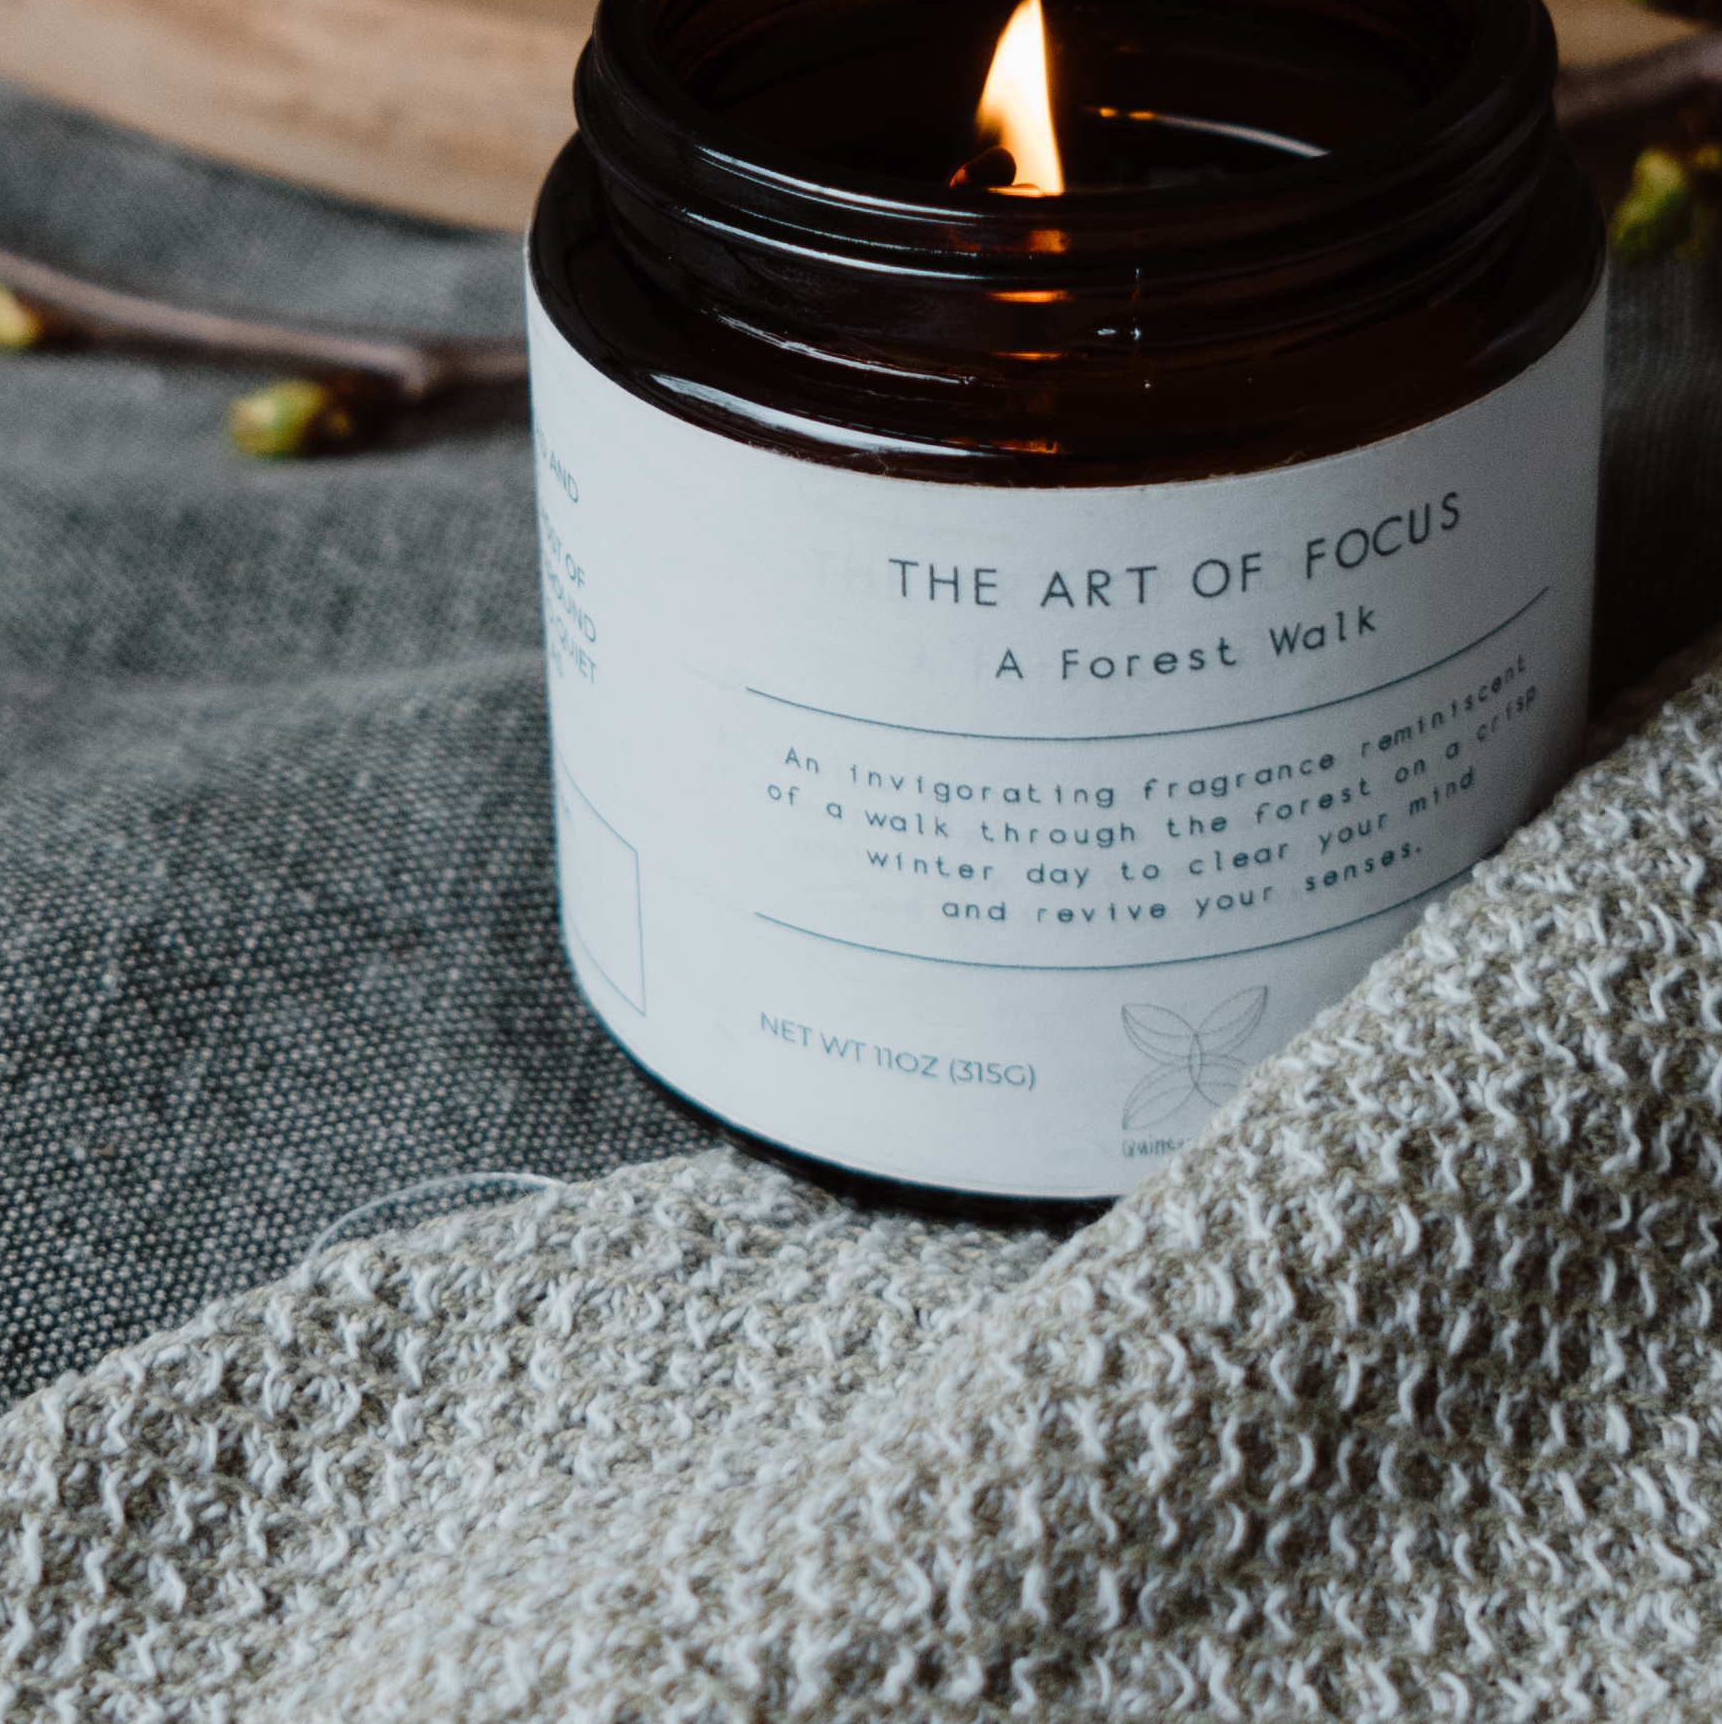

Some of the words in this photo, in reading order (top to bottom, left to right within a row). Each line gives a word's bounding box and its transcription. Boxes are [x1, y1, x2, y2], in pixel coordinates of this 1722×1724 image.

[565, 553, 585, 588] OF
[888, 557, 998, 608] THE
[1039, 564, 1159, 608] ART
[1191, 551, 1262, 600] OF
[1305, 491, 1461, 581] FOCUS
[995, 648, 1025, 680] A
[1061, 636, 1239, 681] Forest
[1268, 605, 1377, 658] Walk
[766, 783, 800, 806] of
[825, 801, 844, 820] a
[864, 811, 950, 839] walk
[980, 821, 1137, 850] through
[1166, 816, 1229, 839] the
[1253, 778, 1372, 825] forest
[1394, 758, 1427, 785] on
[1444, 740, 1461, 761] a
[1476, 684, 1538, 743] crisp
[784, 747, 821, 775] An
[849, 763, 1116, 810] invigorating
[1142, 753, 1336, 801] fragrance
[1361, 654, 1526, 757] reminiscent
[866, 850, 994, 881] winter
[1026, 863, 1090, 889] day
[1120, 861, 1161, 882] to
[1187, 842, 1289, 877] clear
[1318, 810, 1387, 855] your
[1409, 766, 1475, 817] mind
[941, 901, 1007, 923] and
[1036, 902, 1168, 925] revive
[1195, 885, 1274, 920] your
[1305, 839, 1422, 892] senses.
[759, 1011, 813, 1048] NET
[820, 1033, 866, 1063] WT
[949, 1059, 1037, 1092] (315G)
